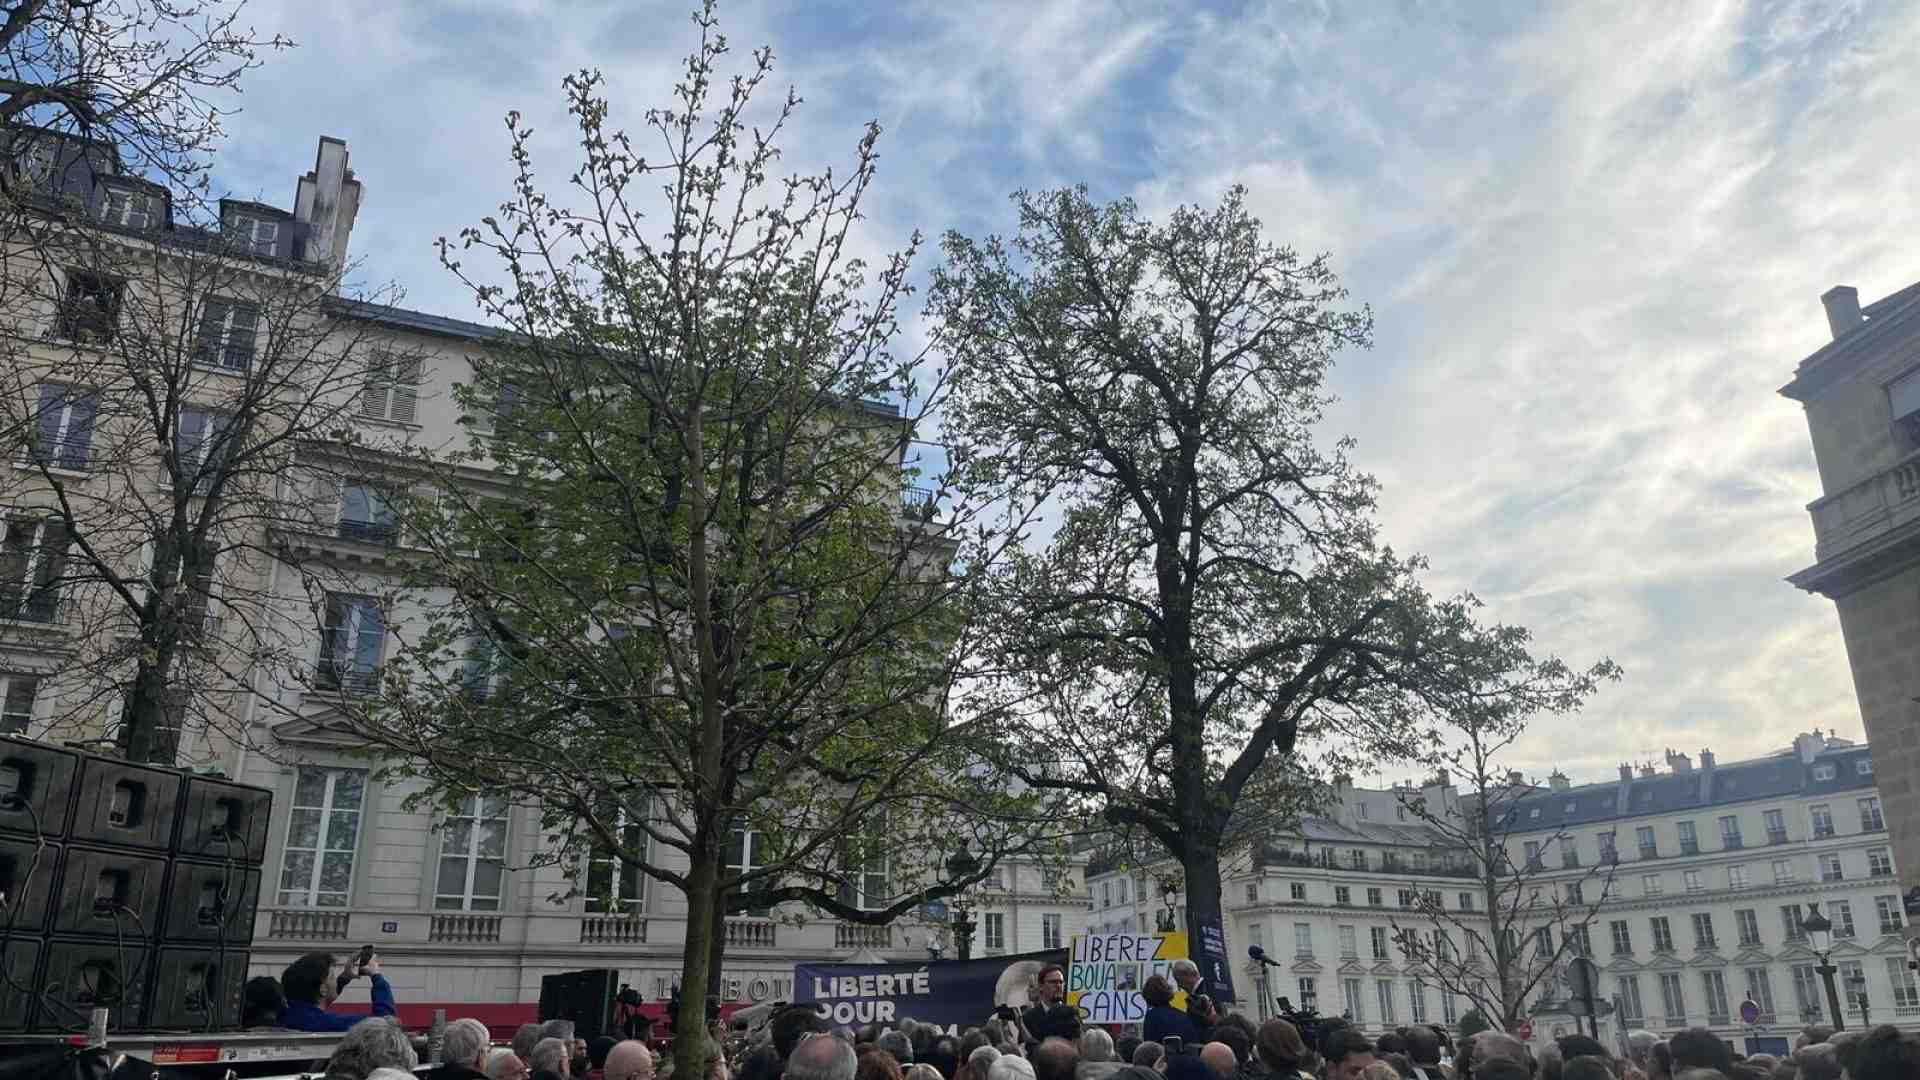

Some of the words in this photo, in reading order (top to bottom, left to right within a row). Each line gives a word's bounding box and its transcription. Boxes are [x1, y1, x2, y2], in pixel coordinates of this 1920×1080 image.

[1071, 934, 1167, 963] LIBÉREZ
[813, 966, 931, 999] LIBERTÉ
[1070, 962, 1173, 991] BOUAL
